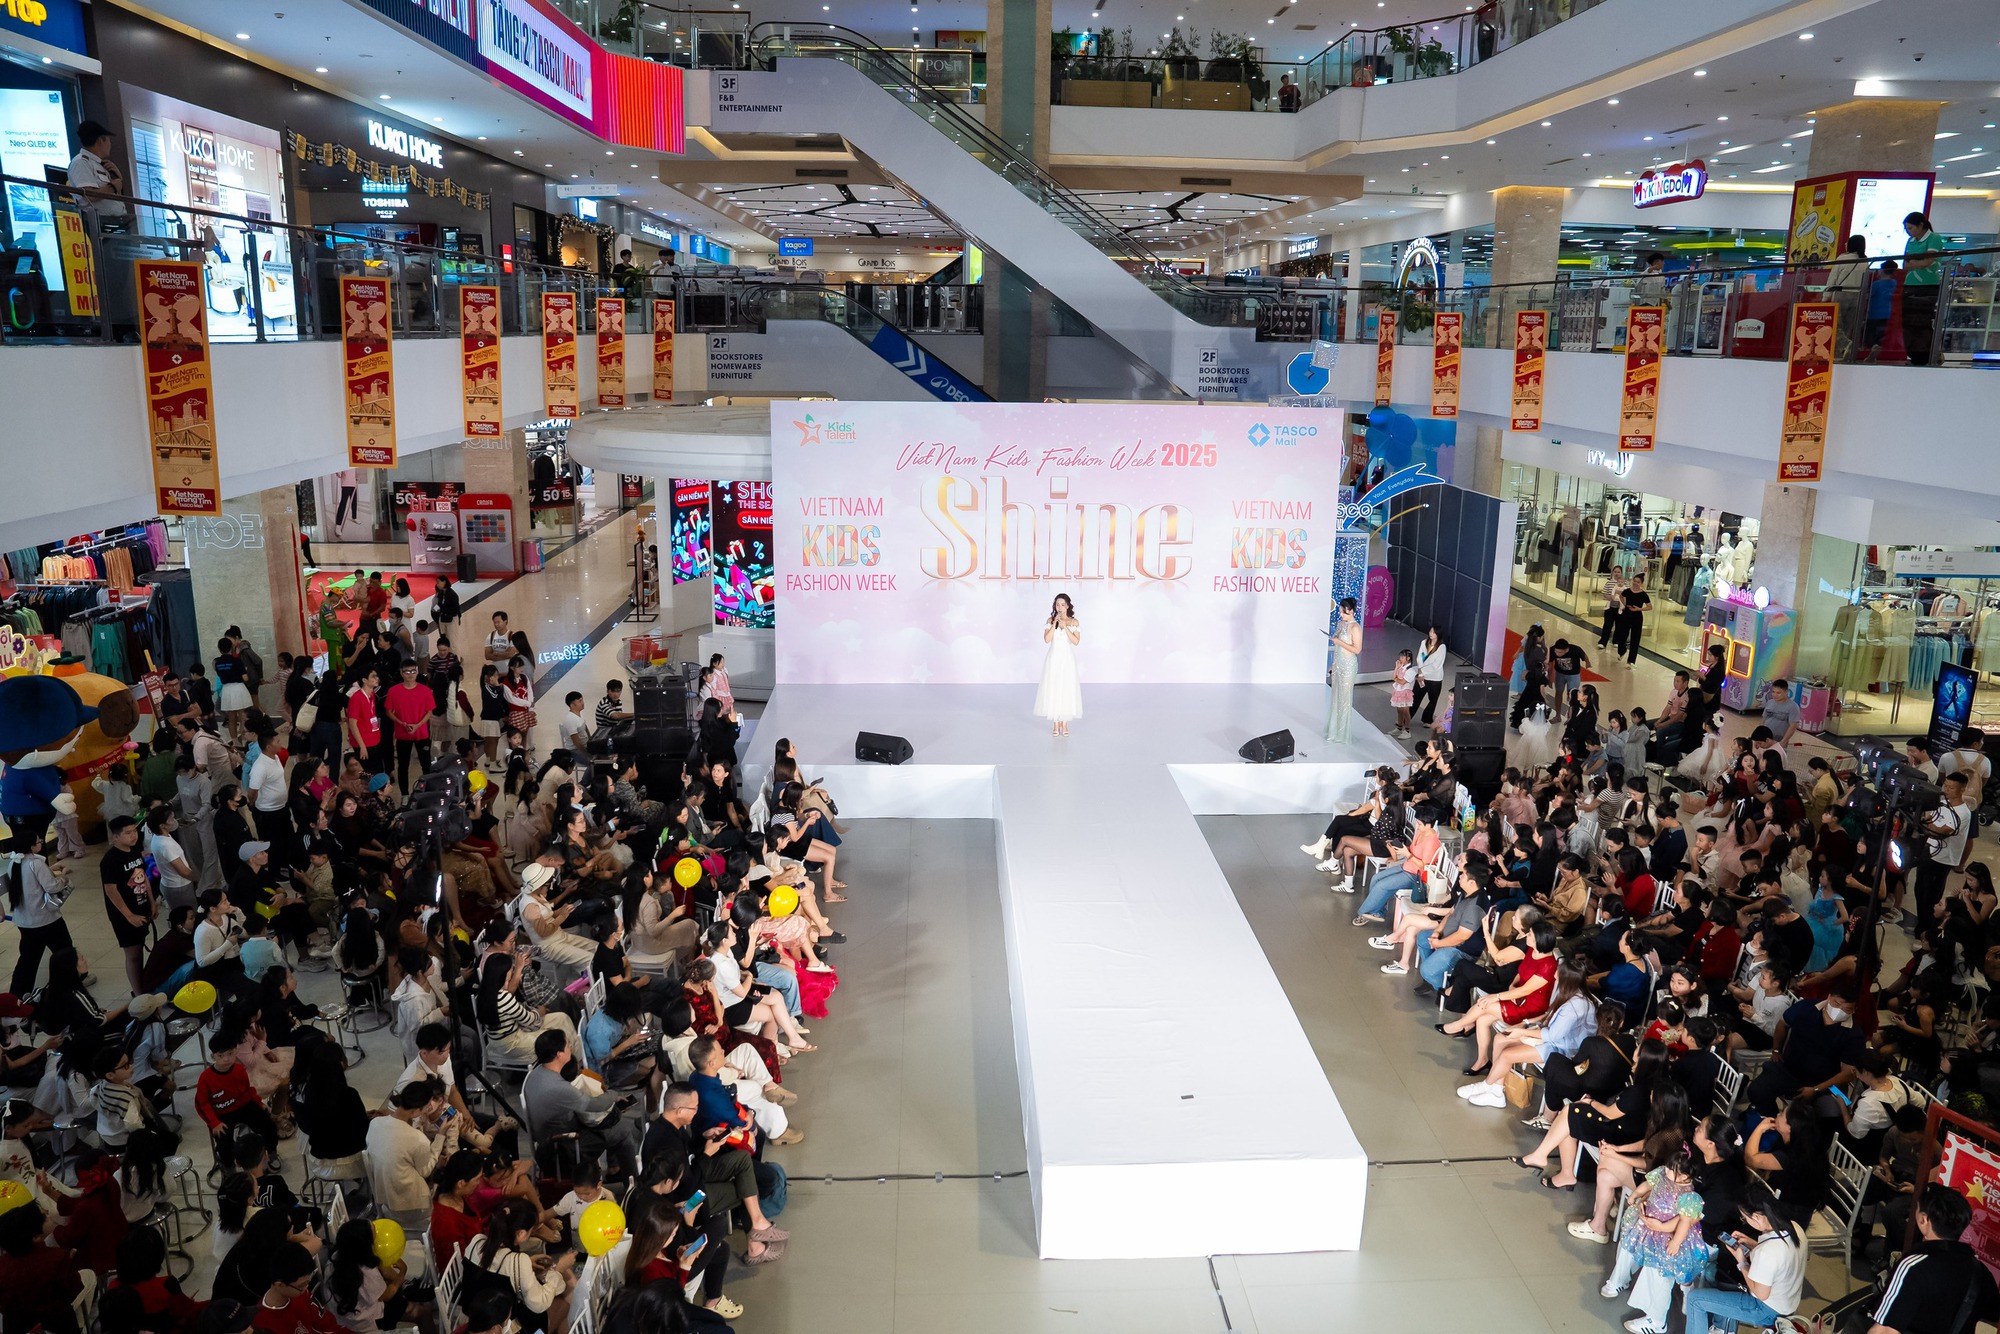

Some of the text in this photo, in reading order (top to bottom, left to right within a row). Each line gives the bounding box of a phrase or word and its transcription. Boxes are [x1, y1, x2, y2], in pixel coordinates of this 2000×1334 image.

[0, 0, 47, 26] TOP
[532, 28, 561, 88] TASCO
[721, 78, 736, 89] 3F
[719, 94, 735, 102] F&B
[719, 104, 783, 113] ENTERTAINMENT
[9, 139, 58, 149] Neo QLED 8K
[216, 142, 256, 172] HOME
[408, 134, 443, 169] HOME
[362, 197, 410, 208] TOSHIBA
[784, 240, 808, 249] kagoo
[857, 257, 896, 267] GRAND BOIS
[712, 337, 727, 349] 2F
[710, 353, 763, 362] BOOKSTORES
[1202, 352, 1216, 363] 2F
[710, 362, 762, 371] HOMEWARES
[1199, 367, 1250, 376] BOOKSTORES
[710, 371, 753, 380] FURNITURE
[1198, 376, 1248, 385] HOMEWARES
[1198, 385, 1239, 394] FURNITURE
[824, 428, 857, 441] Talent
[1273, 425, 1318, 437] TASCO
[1275, 437, 1297, 446] Mall
[983, 444, 1031, 471] Kids
[1036, 446, 1105, 476] Fashion
[1109, 438, 1159, 471] Week
[1160, 442, 1218, 468] 2025
[737, 500, 757, 510] THE
[799, 497, 884, 517] VIETNAM
[1231, 500, 1313, 520] VIETNAM
[919, 475, 1195, 581] Shine
[802, 524, 882, 567] KIDS
[1230, 526, 1308, 570] KIDS
[786, 574, 897, 591] FASHION WEEK
[1213, 575, 1320, 593] FASHION WEEK
